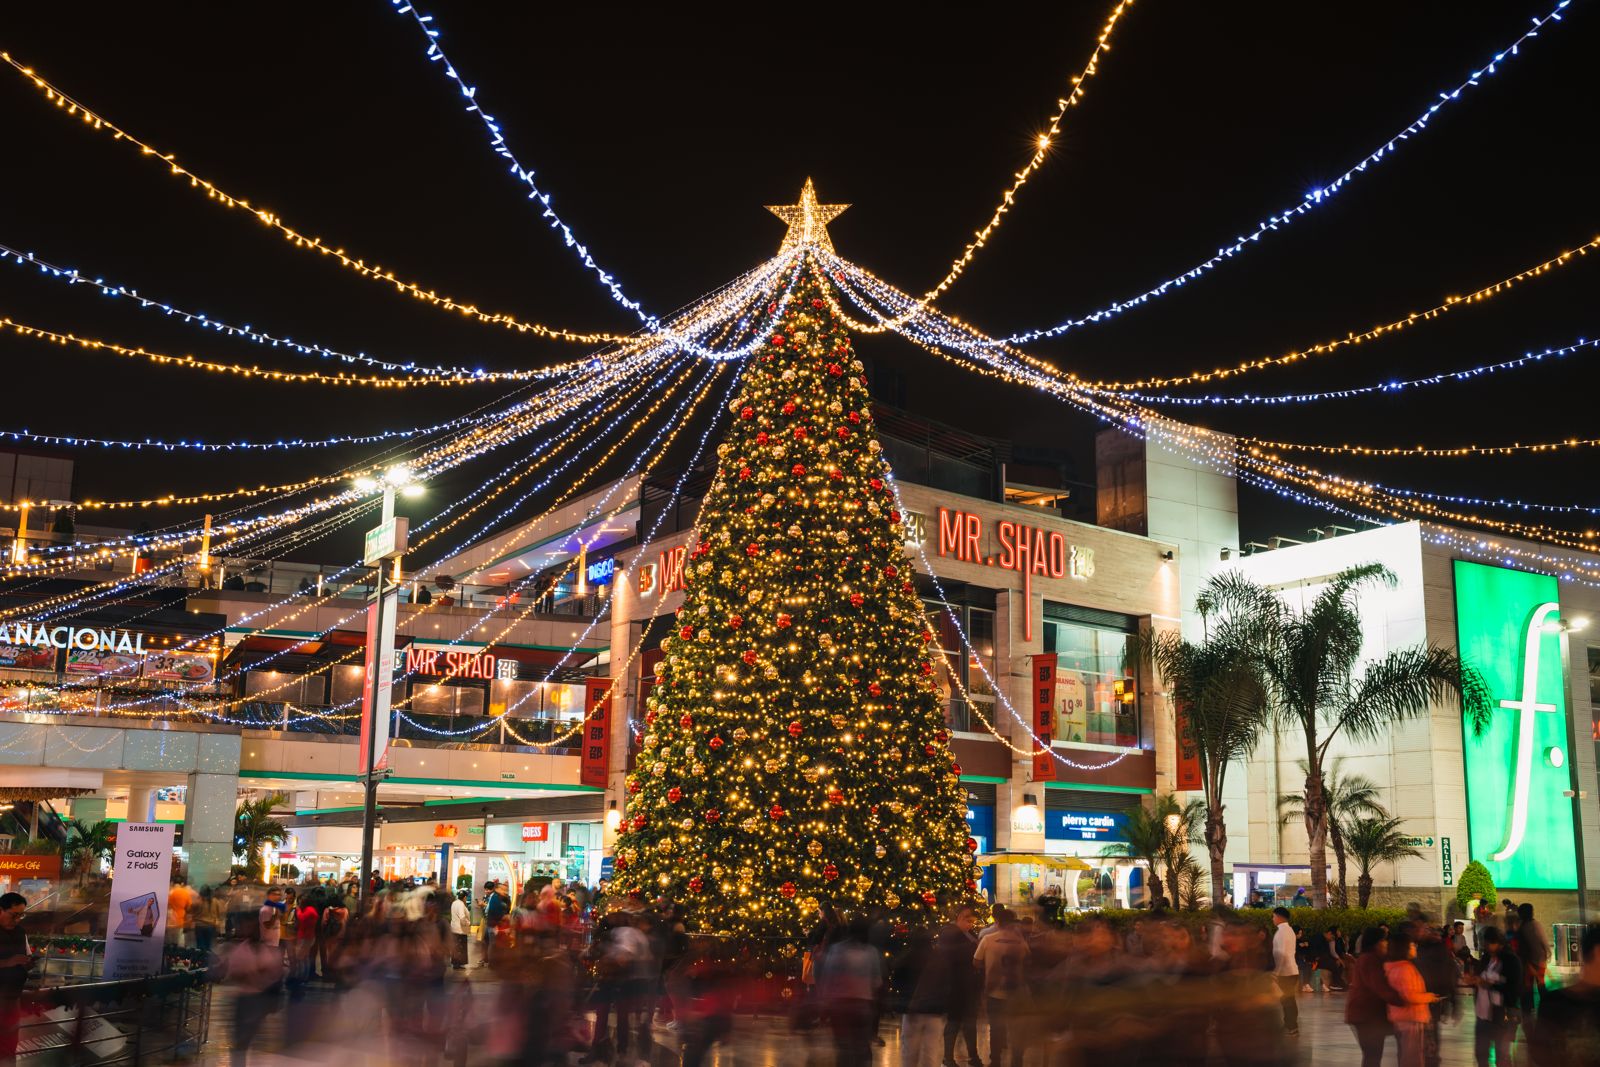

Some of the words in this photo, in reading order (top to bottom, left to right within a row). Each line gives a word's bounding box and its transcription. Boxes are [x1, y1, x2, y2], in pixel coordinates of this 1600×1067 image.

[588, 558, 614, 581] DISCO
[938, 506, 994, 567] MR.
[1000, 520, 1065, 642] SHAO
[406, 648, 442, 676] MR.
[445, 651, 496, 680] SHAO
[1056, 677, 1076, 686] RANGE
[1062, 814, 1088, 827] pierre
[1089, 816, 1115, 827] cardin
[128, 825, 164, 833] SAMSUNG
[522, 826, 541, 838] GUESS
[126, 850, 161, 860] Galaxy
[127, 861, 133, 869] Z
[134, 861, 159, 870] Fold5
